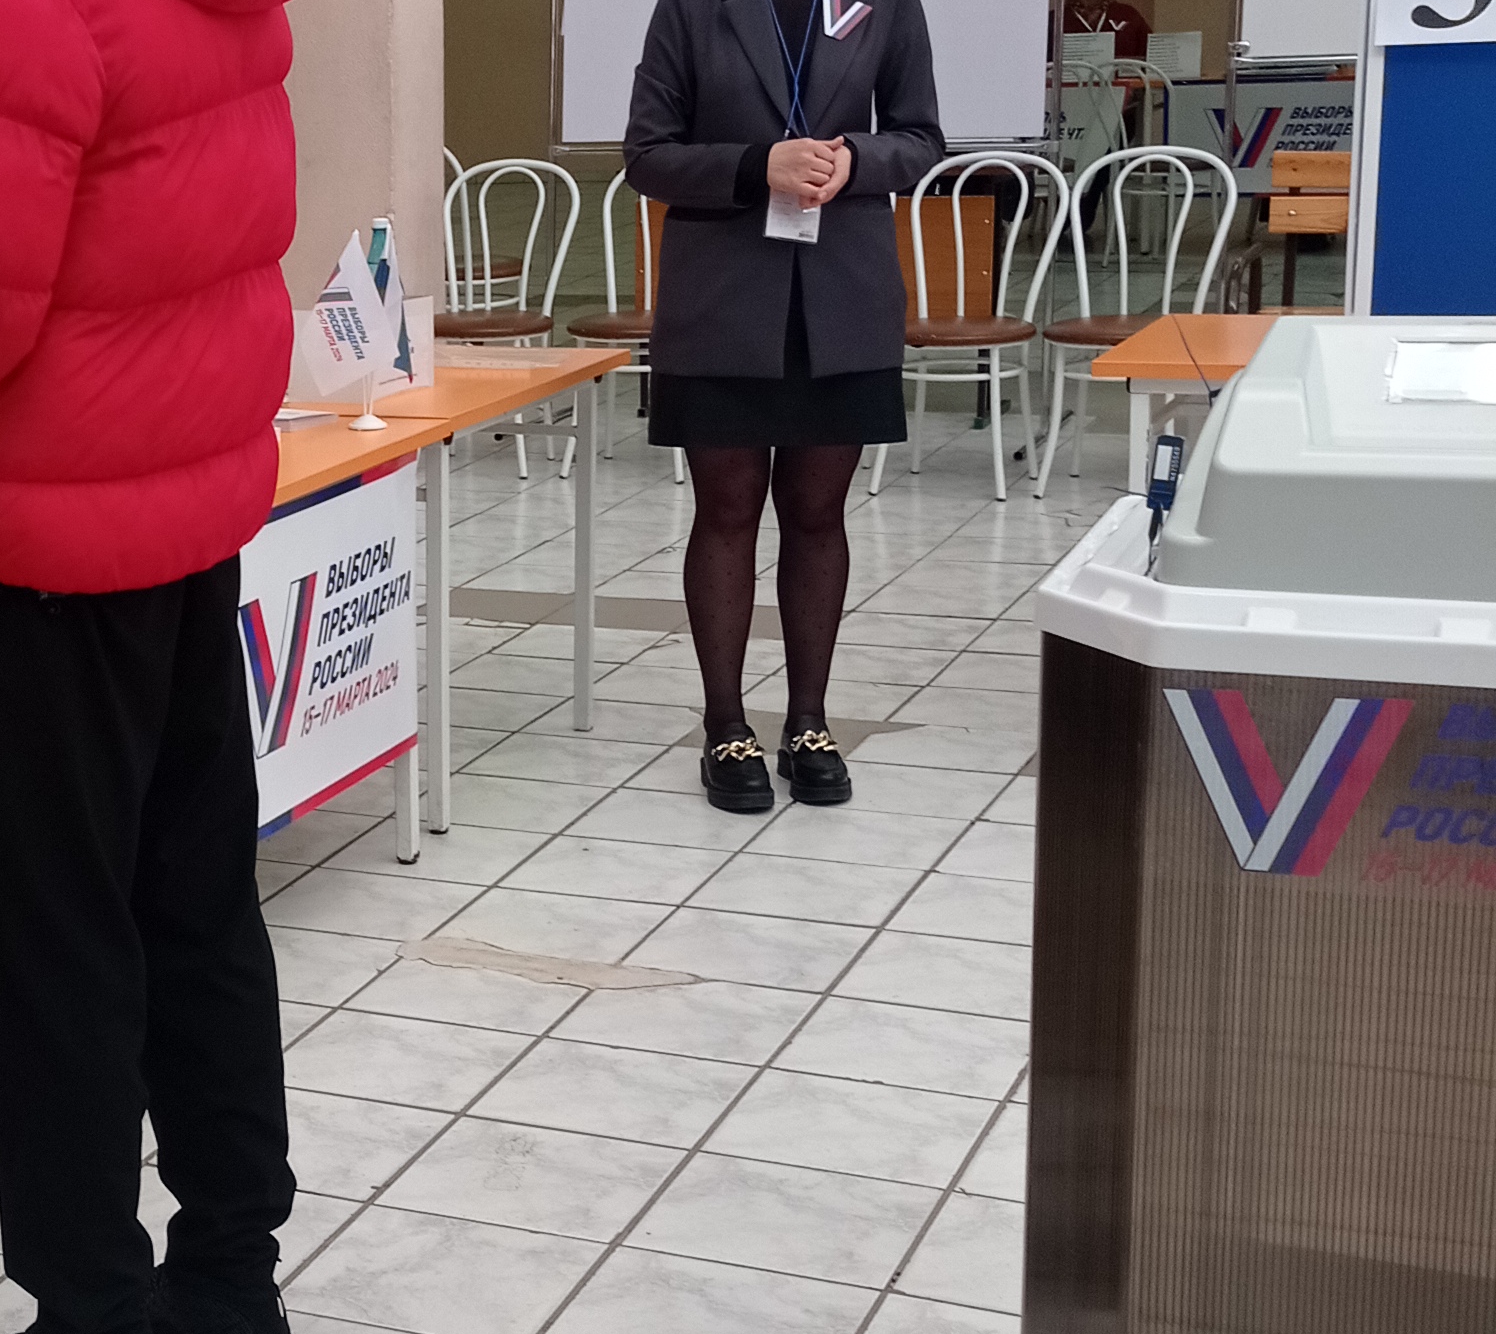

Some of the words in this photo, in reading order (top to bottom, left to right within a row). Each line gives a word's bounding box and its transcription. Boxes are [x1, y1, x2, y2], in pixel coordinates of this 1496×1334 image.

[1282, 123, 1353, 137] ПРЕЗИДЕ
[324, 308, 346, 342] РОССИИ
[336, 307, 365, 361] ПРЕЗИДЕНТА
[347, 307, 370, 344] ВЫБОРЫ
[325, 536, 396, 599] ВЫБОРЫ
[316, 570, 411, 647] ПРЕЗИДЕНТА
[308, 633, 374, 696] РОССИИ
[333, 674, 372, 720] МАРТА
[372, 659, 399, 698] 2024
